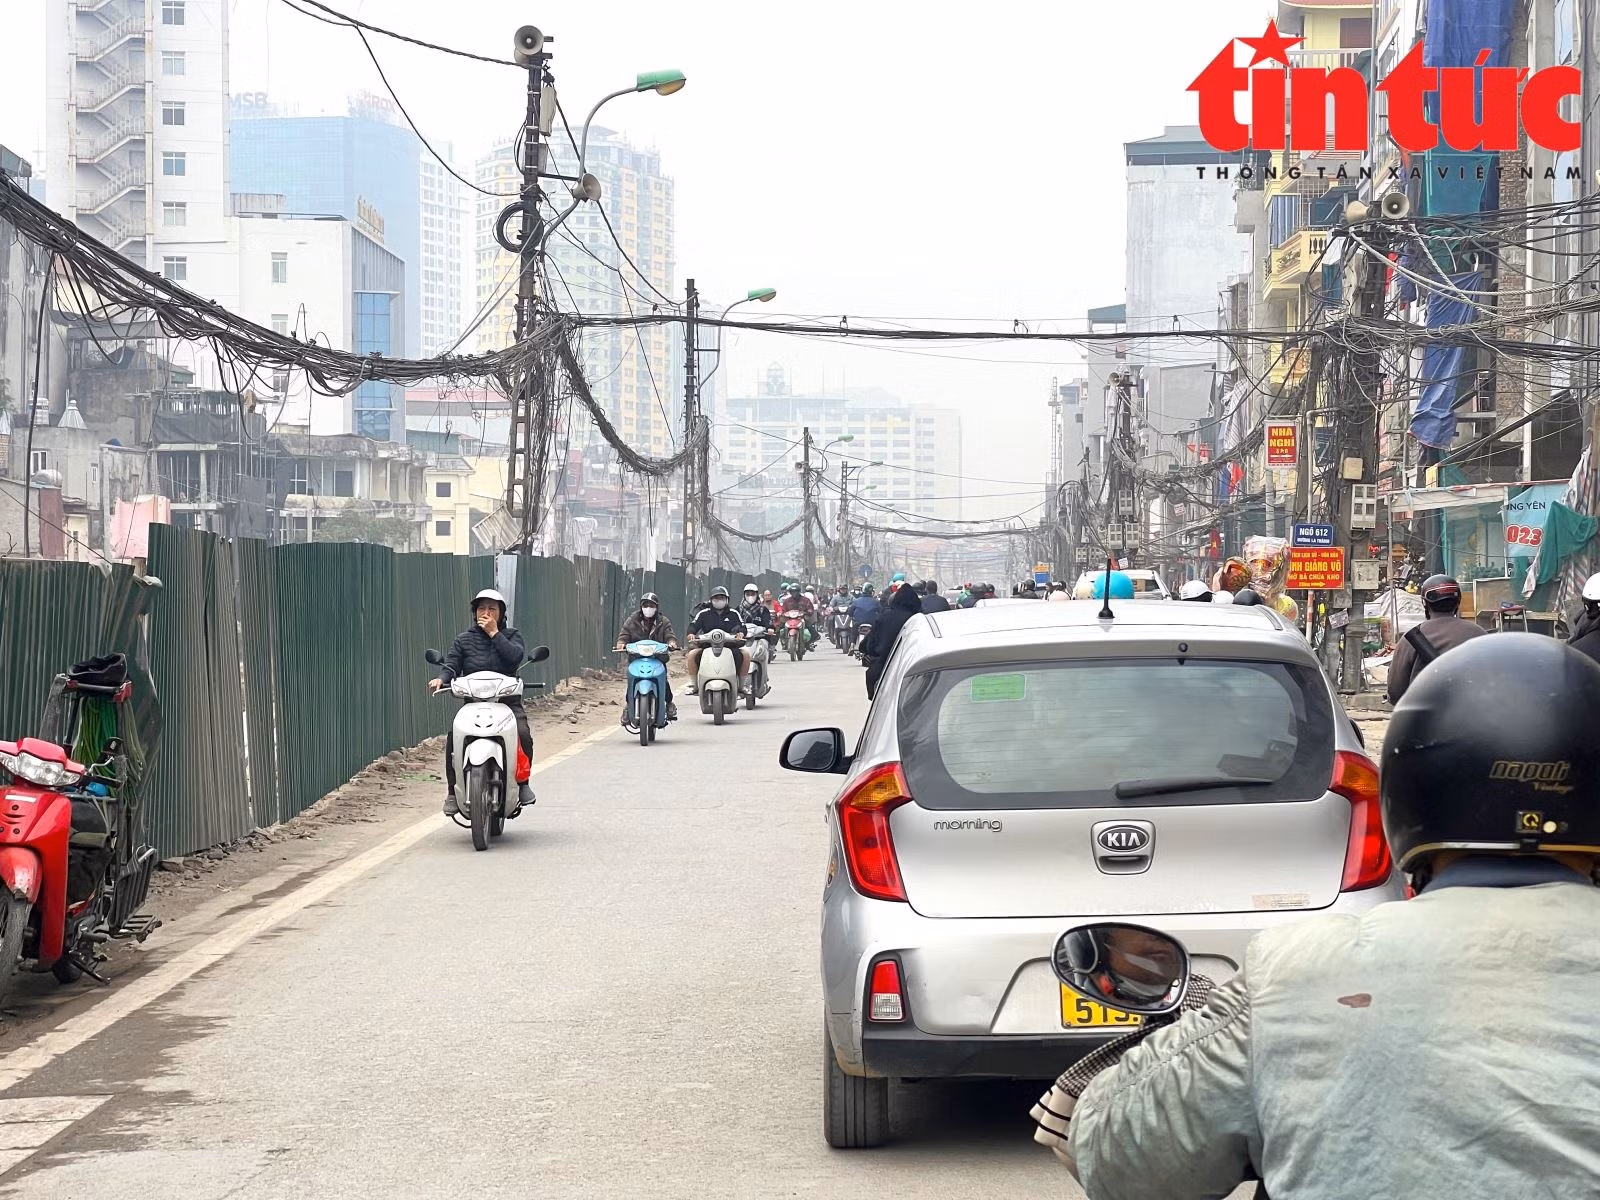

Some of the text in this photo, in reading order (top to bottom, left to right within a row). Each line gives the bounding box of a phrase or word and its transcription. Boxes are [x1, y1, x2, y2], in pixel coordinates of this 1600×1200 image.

[1526, 500, 1546, 510] YÊN
[933, 818, 1003, 833] morning
[1107, 832, 1141, 847] KIA
